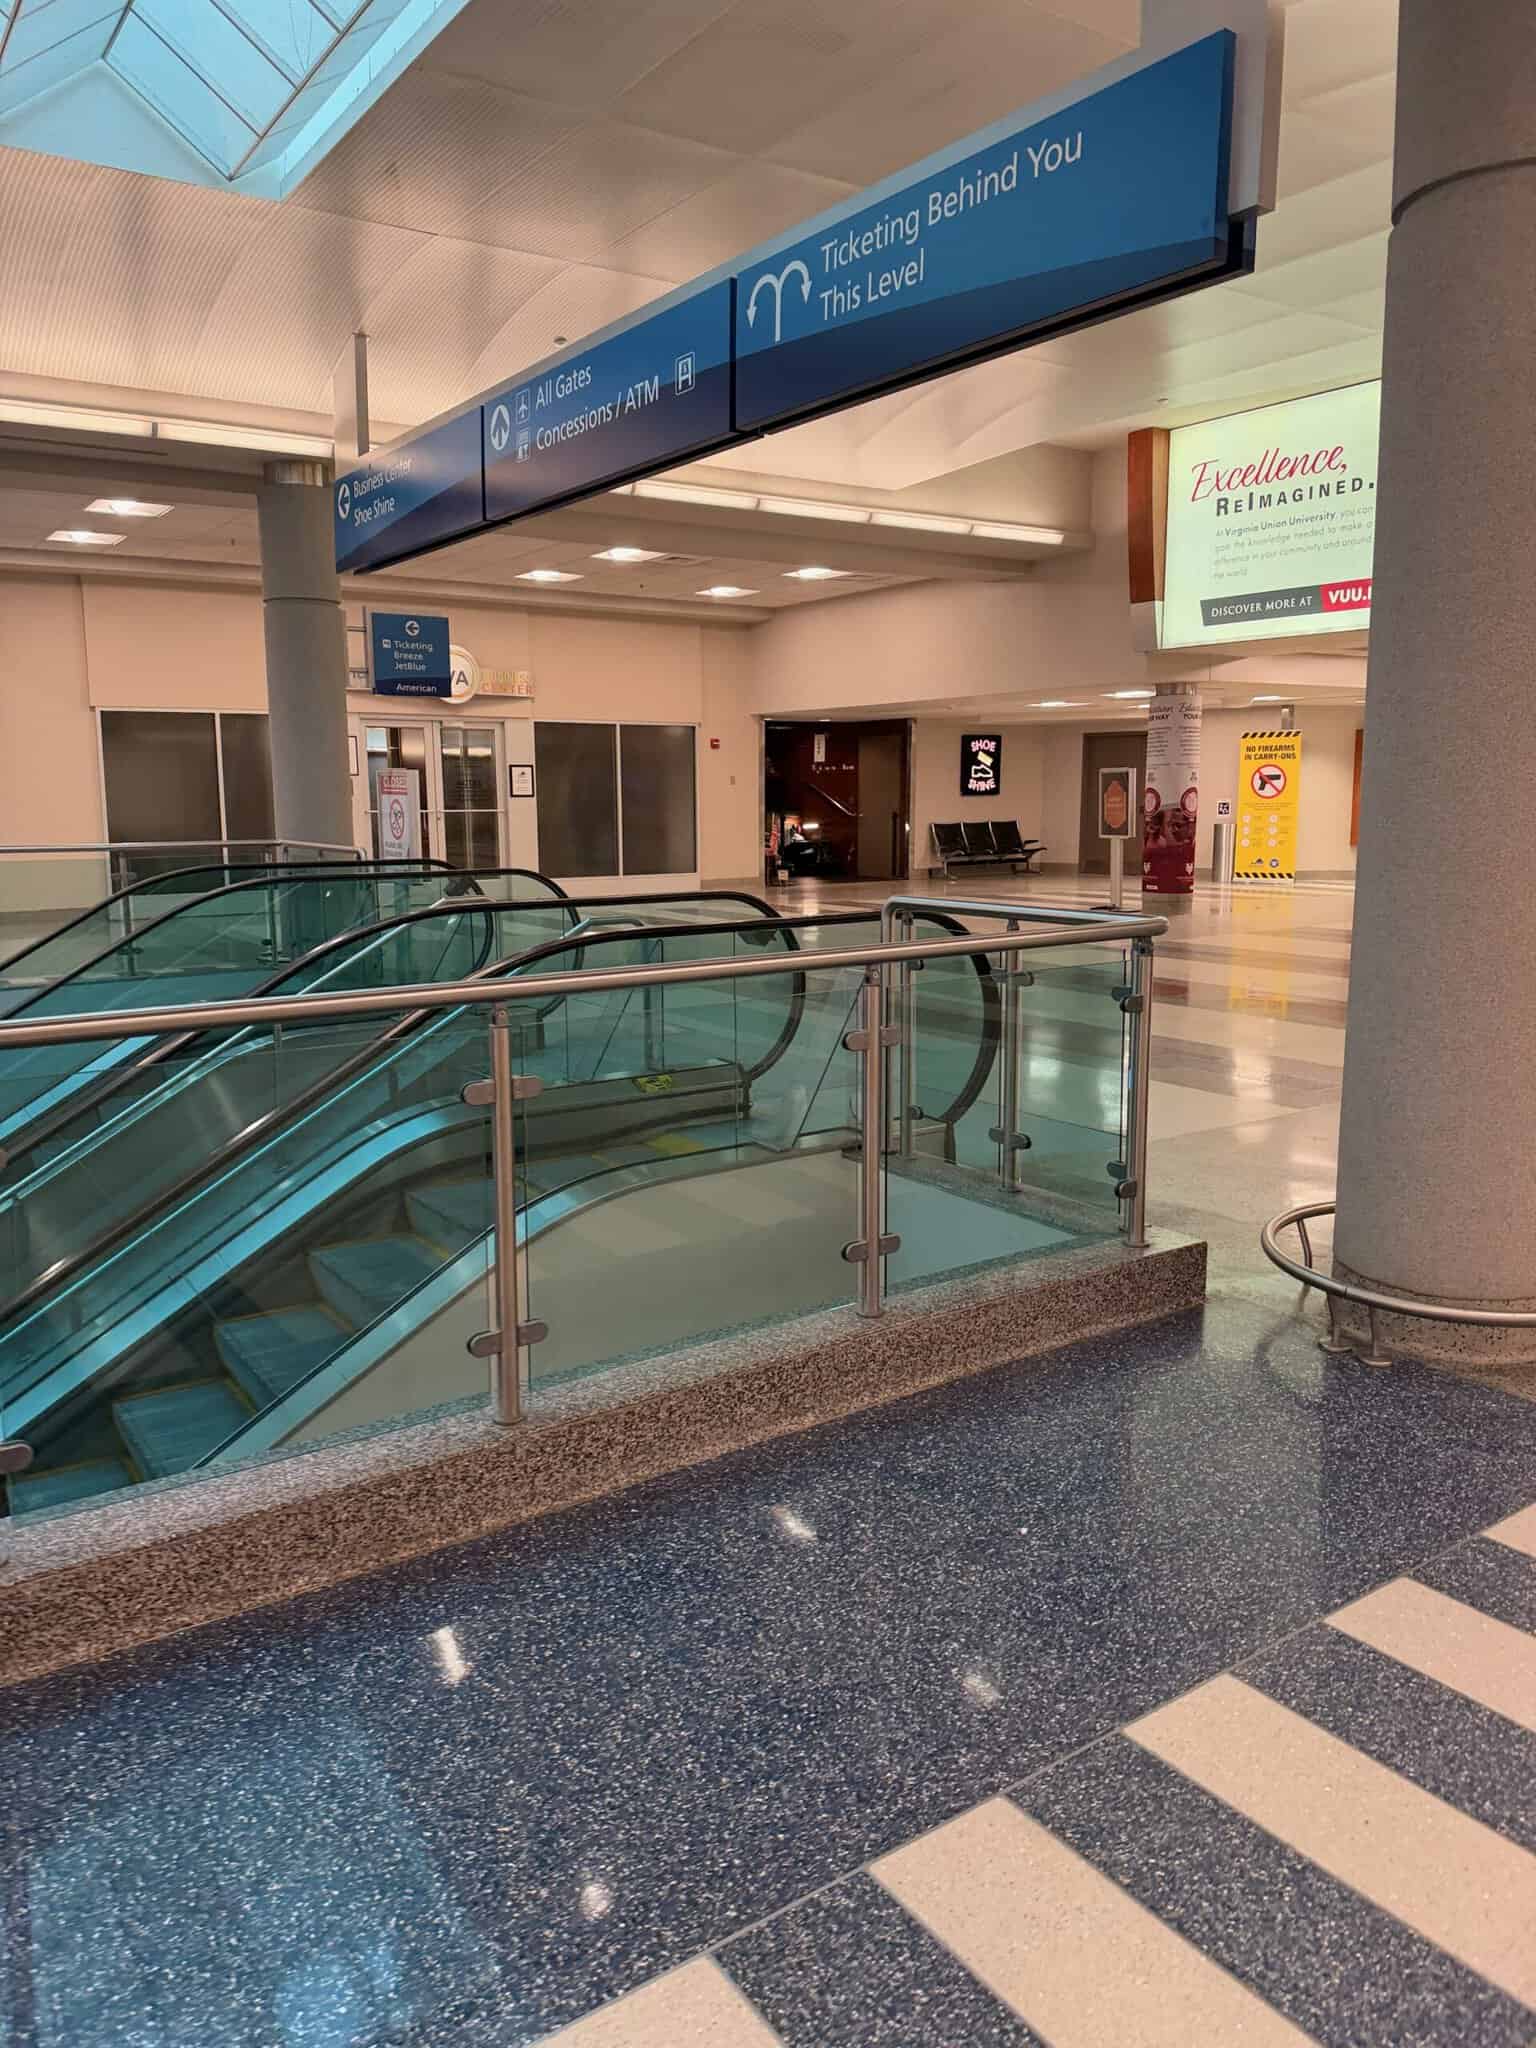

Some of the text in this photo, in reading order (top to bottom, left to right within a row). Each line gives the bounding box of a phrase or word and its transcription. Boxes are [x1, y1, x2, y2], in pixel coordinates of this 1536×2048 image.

[821, 131, 1082, 273] Ticketing Behind You
[820, 248, 924, 321] This Level
[535, 365, 592, 409] All Gates
[536, 401, 613, 451] Concessions
[624, 375, 659, 414] ATM
[353, 458, 412, 498] Business Center
[1191, 446, 1348, 502] Excellence,
[354, 496, 395, 527] Shoe Shine
[1260, 519, 1287, 530] Union
[1211, 596, 1312, 617] DISCOVER MORE AT
[393, 640, 433, 652] Ticketing
[394, 652, 424, 661] Breeze
[394, 662, 427, 671] JetBlue
[396, 683, 437, 693] American
[970, 739, 997, 752] SHOE
[1246, 743, 1296, 752] NO FIREARMS
[1254, 752, 1297, 760] CARRY-ONS
[968, 777, 996, 792] SHINE
